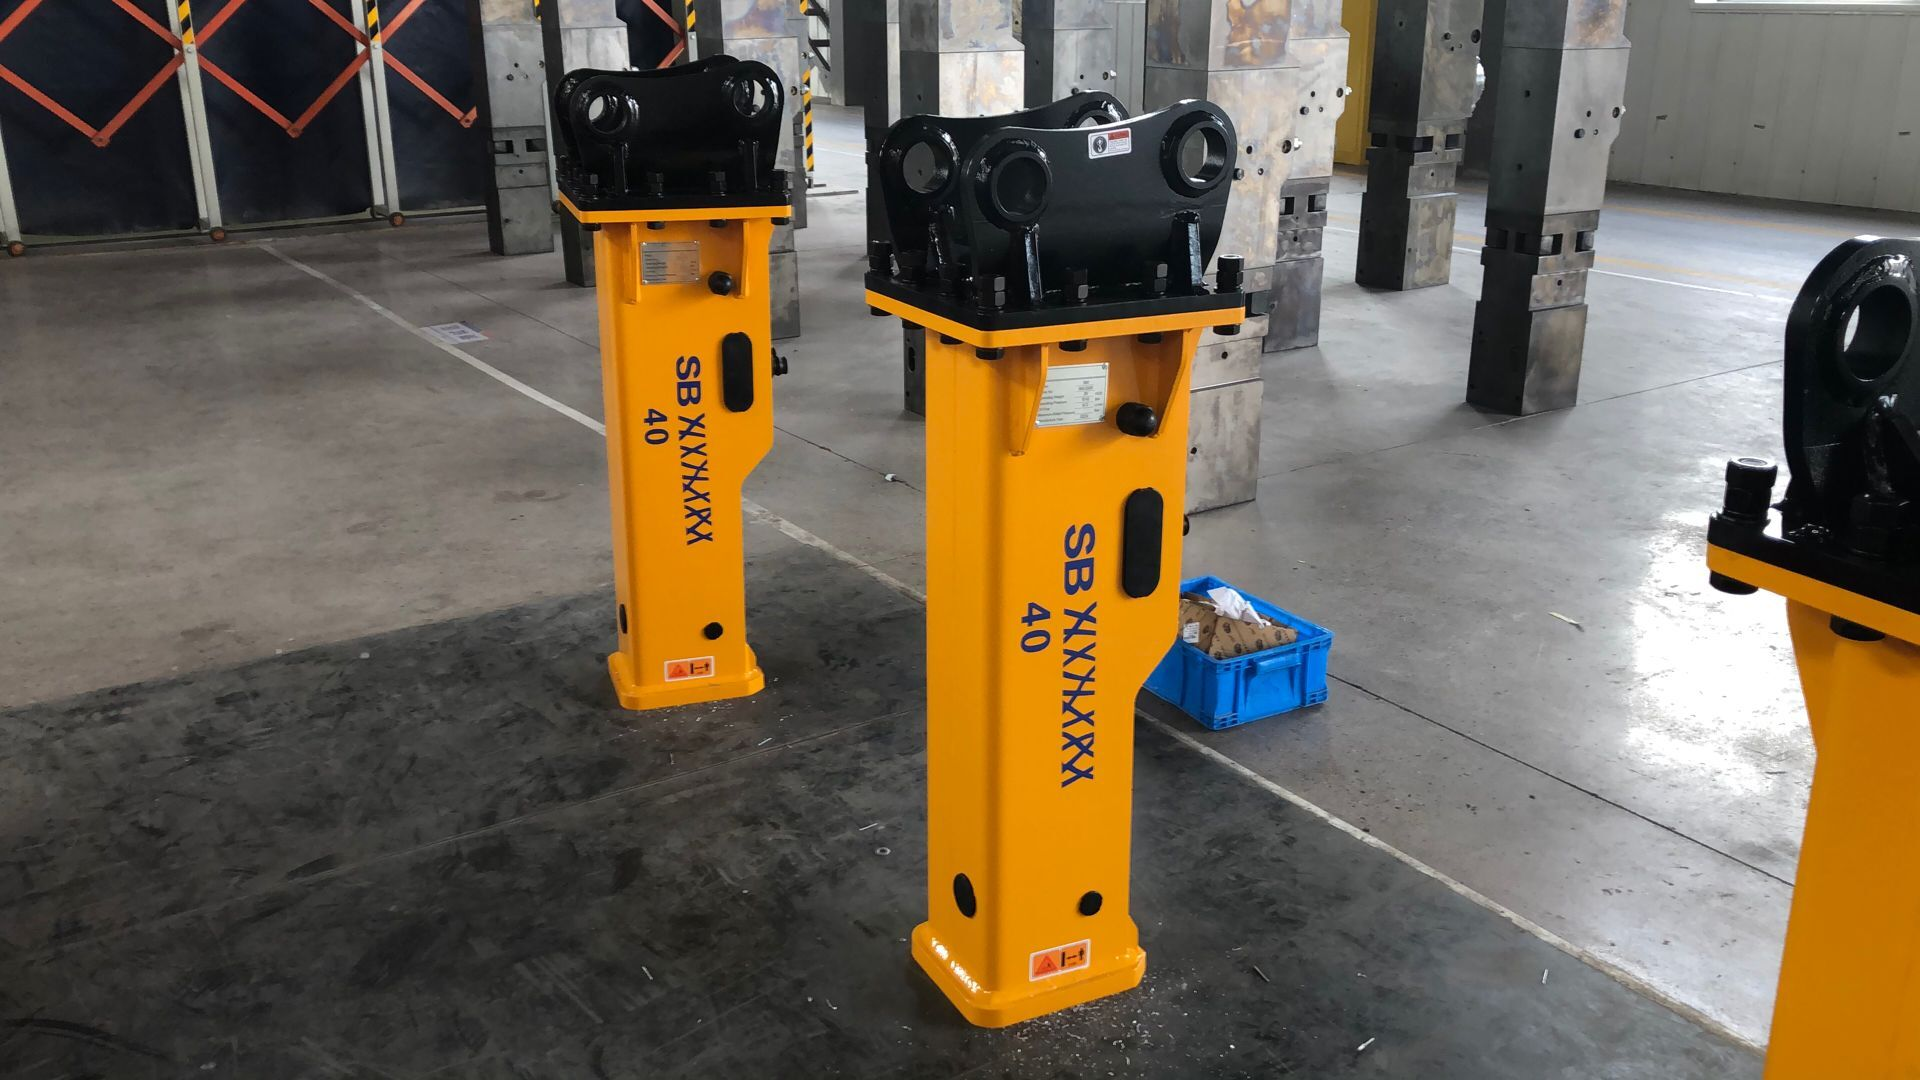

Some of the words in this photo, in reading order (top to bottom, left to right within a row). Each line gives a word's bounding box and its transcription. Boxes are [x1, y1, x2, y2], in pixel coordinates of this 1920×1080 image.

[676, 356, 701, 407] SB
[644, 408, 669, 445] 40
[1064, 523, 1096, 596] SB
[1020, 602, 1051, 653] 40
